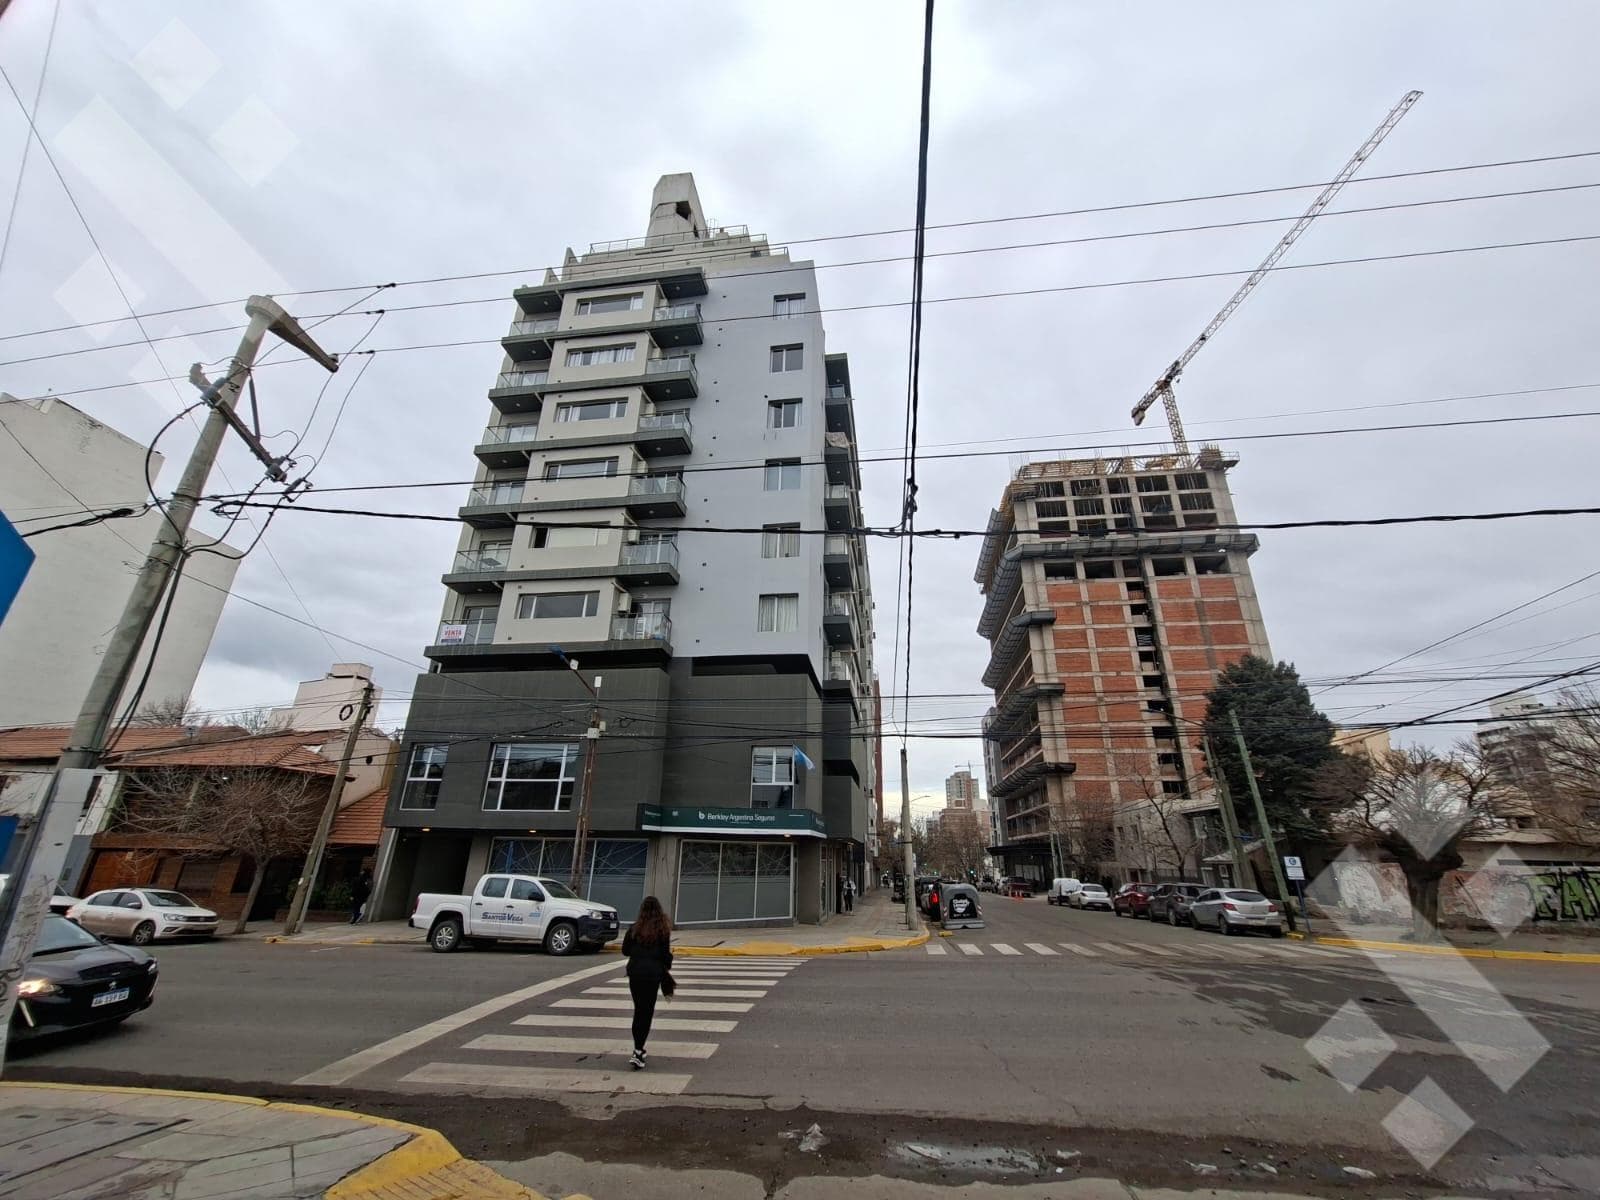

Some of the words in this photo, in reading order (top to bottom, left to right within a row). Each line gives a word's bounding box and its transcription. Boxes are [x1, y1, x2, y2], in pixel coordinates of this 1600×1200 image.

[707, 812, 729, 822] Berkley
[730, 813, 754, 822] Argentina
[755, 813, 776, 822] Seguros
